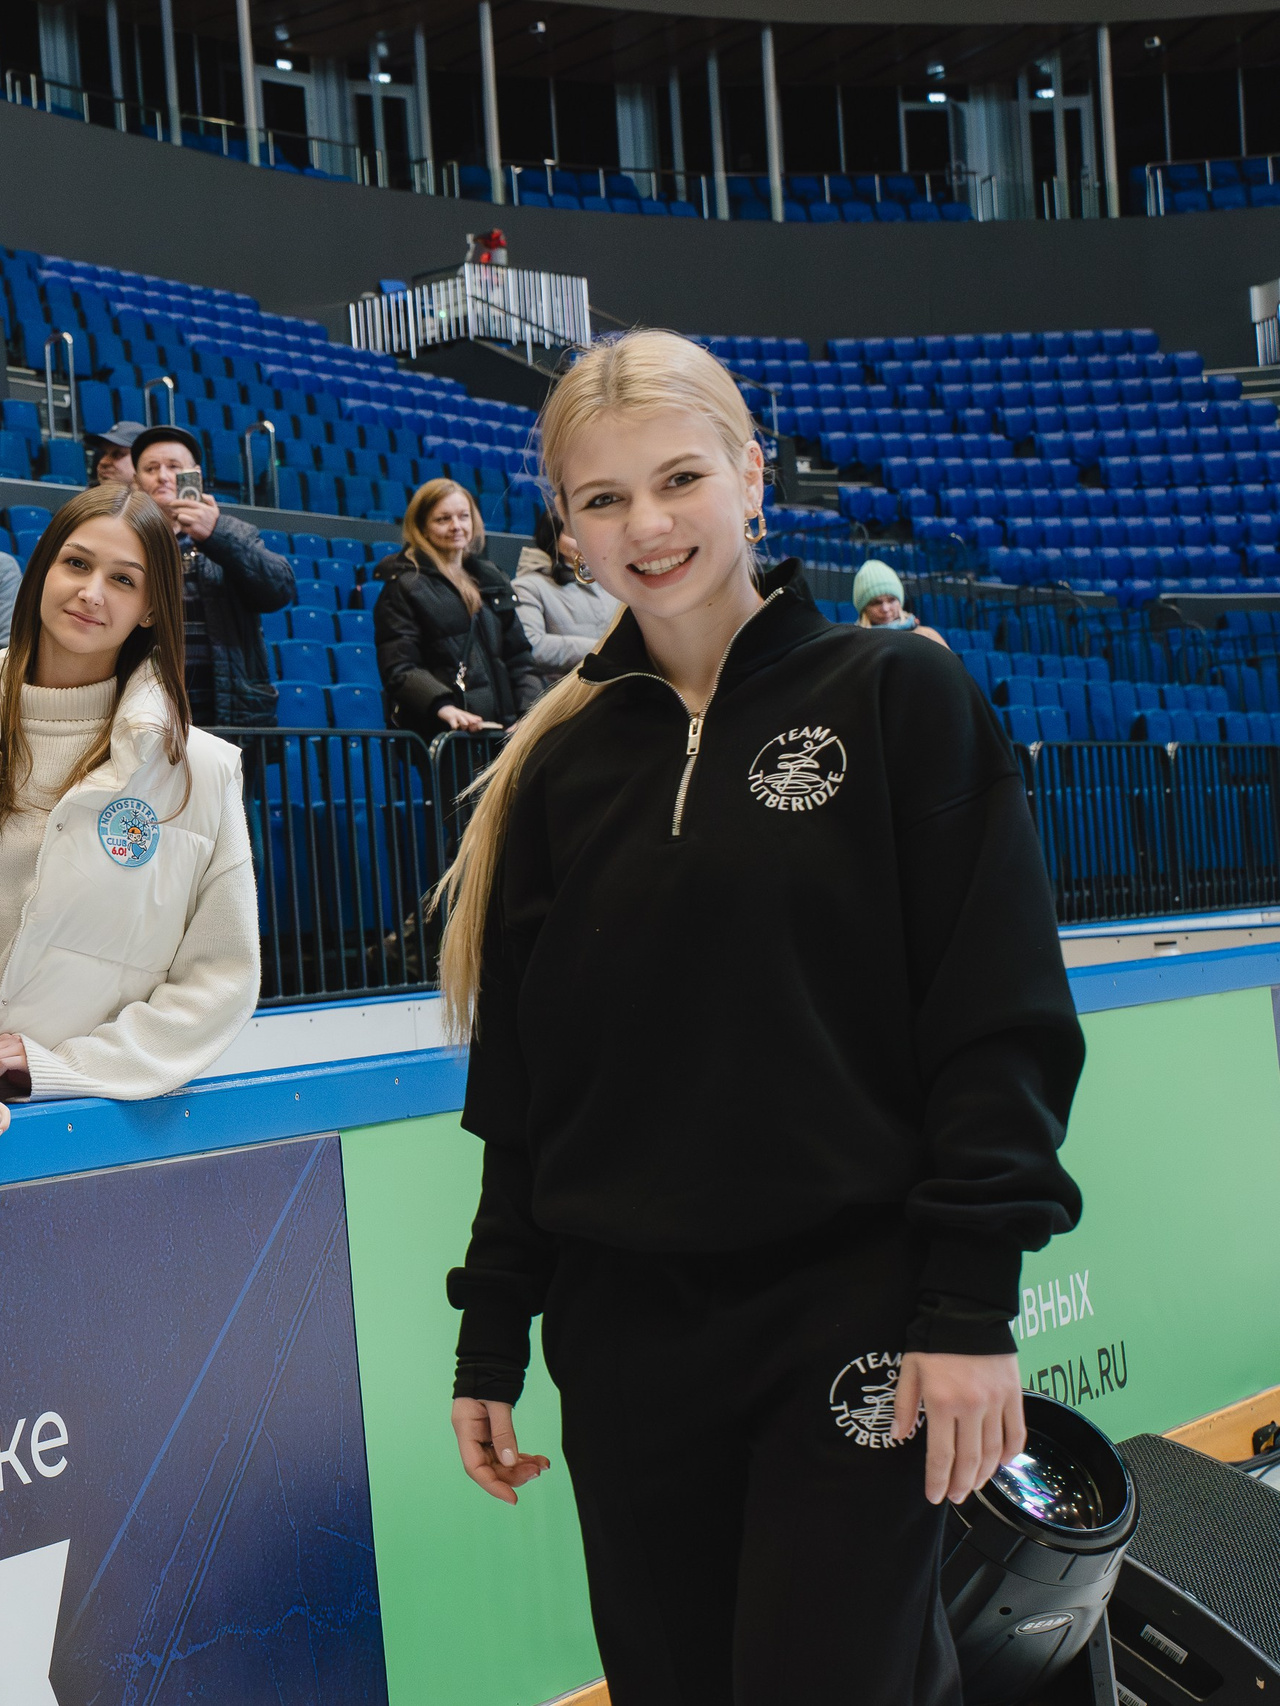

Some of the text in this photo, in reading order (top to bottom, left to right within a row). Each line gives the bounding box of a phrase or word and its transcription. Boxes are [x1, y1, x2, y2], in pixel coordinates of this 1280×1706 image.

[773, 726, 831, 745] TEAM
[748, 769, 844, 811] TUTBERIDZE
[106, 837, 128, 847] CLUB
[111, 847, 127, 857] 6.0!
[830, 1400, 926, 1449] TUTBER
[1022, 1616, 1070, 1630] BEAM
